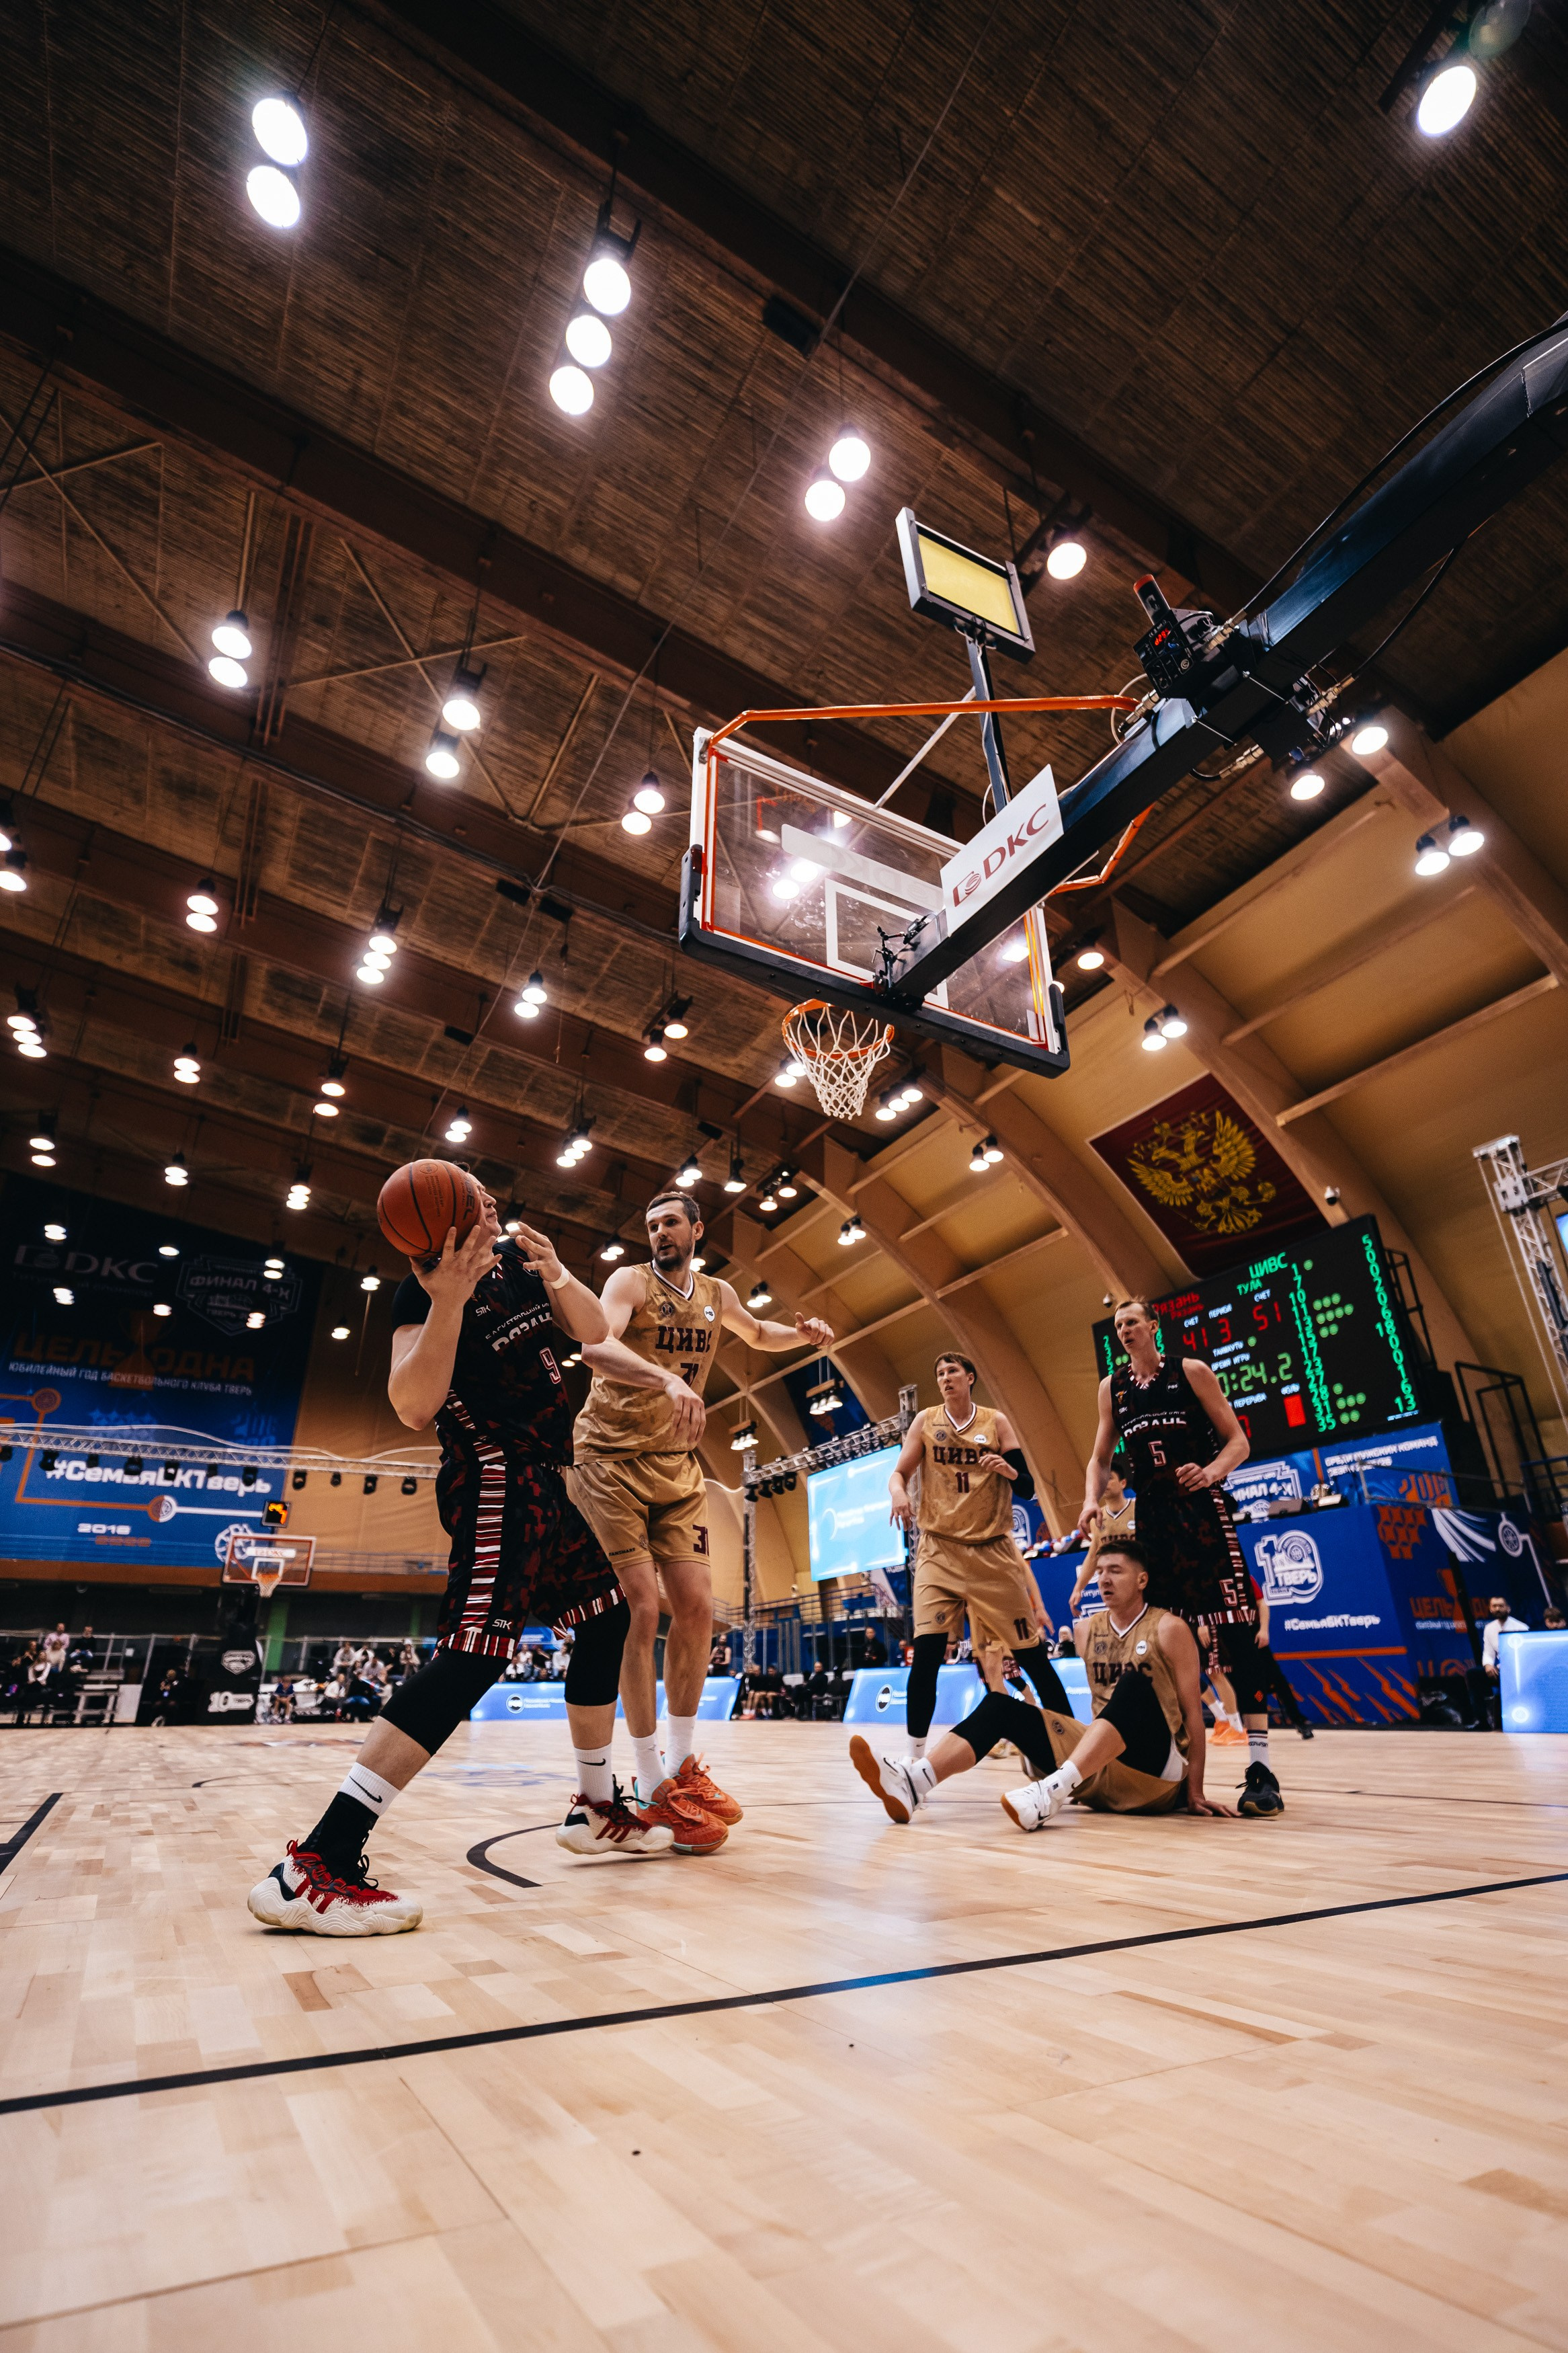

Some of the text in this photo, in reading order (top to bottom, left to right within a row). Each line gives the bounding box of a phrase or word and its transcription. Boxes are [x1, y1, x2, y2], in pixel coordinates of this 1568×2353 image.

[983, 803, 1049, 879] DKC
[1249, 1252, 1288, 1279] ЦИВС
[1291, 1234, 1372, 1277] 1 5
[64, 1251, 159, 1284] DKC
[1293, 1248, 1376, 1289] 7 0
[1369, 1263, 1380, 1277] 0
[188, 1275, 257, 1292] ФИНАЛ
[1237, 1278, 1263, 1295] ТУЛА
[1373, 1277, 1384, 1293] 2
[1253, 1288, 1272, 1302] СЧЕТ
[1376, 1291, 1388, 1306] 0
[475, 1305, 491, 1317] STK
[1208, 1303, 1233, 1319] ПЕРИОД
[1252, 1301, 1282, 1331] 51
[1381, 1304, 1392, 1320] 6
[1184, 1315, 1199, 1328] СЧЕТ
[1218, 1317, 1232, 1344] 3
[1375, 1318, 1396, 1338] 18
[491, 1312, 552, 1357] РЯЗАН
[1183, 1327, 1208, 1351] 41
[1388, 1333, 1400, 1349] 0
[13, 1333, 256, 1382] ЦЕЛЬ ОДНА
[539, 1347, 561, 1384] 9
[1210, 1352, 1251, 1372] ВРЕМЯ ИГРЫ
[1392, 1348, 1404, 1365] 0
[8, 1361, 253, 1396] ЮБИЛЕЙНЫЙ ГОД БАСКЕТБОЛЬНОГО КЛУБА ТВЕРЬ
[1397, 1363, 1406, 1380] 1
[1400, 1378, 1412, 1395] 6
[1233, 1392, 1268, 1409] ПЕРЕРЫВА
[1394, 1393, 1416, 1413] 13
[1148, 1440, 1167, 1467] 5
[955, 1472, 970, 1493] 11
[1231, 1482, 1267, 1503] ИНАЛ
[1275, 1569, 1317, 1587] ТВЕРЬ
[1219, 1579, 1238, 1607] 5
[1410, 1597, 1453, 1618] ЦЕЛЬ
[492, 1618, 512, 1630] STK
[1014, 1618, 1029, 1640] 11
[1284, 1613, 1381, 1631] #СемьяБКТверь
